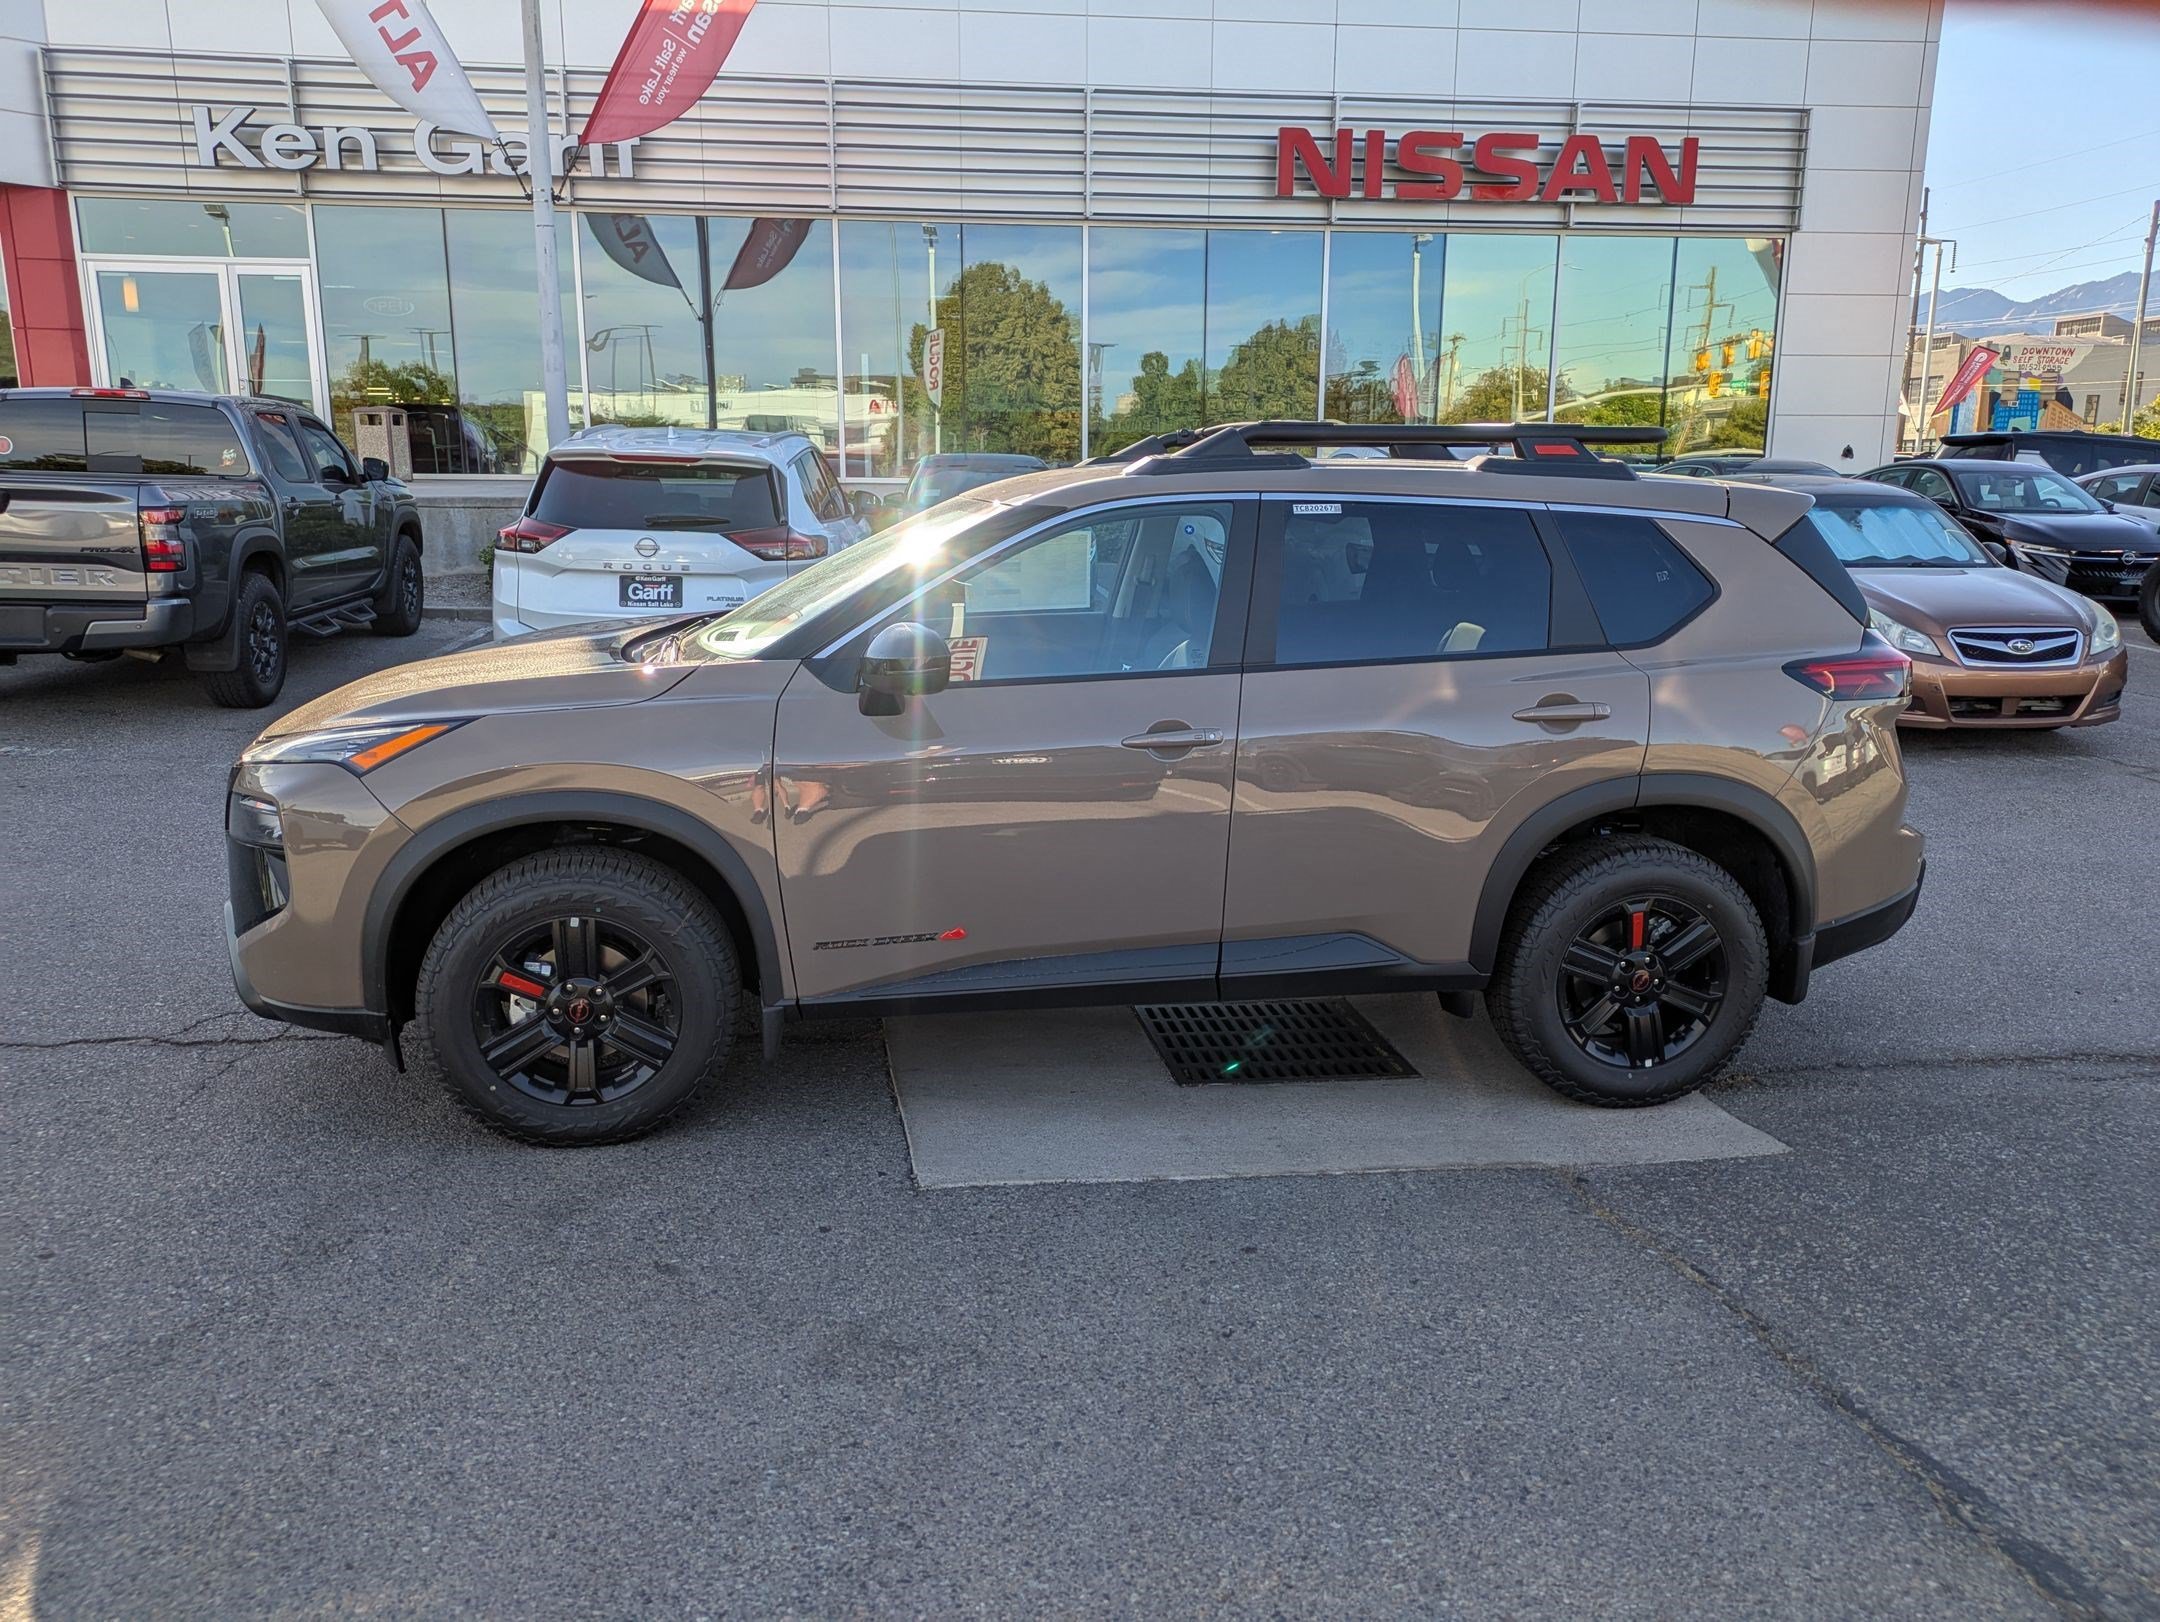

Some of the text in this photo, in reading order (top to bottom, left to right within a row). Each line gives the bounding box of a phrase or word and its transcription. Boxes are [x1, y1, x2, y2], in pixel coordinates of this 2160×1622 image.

[191, 105, 379, 172] Ken
[1275, 126, 1700, 204] NISSAN
[2021, 347, 2076, 357] DOWNTOWN
[2012, 356, 2070, 365] SELF STORAGE
[602, 562, 691, 572] ROGUE
[627, 582, 674, 600] Garff
